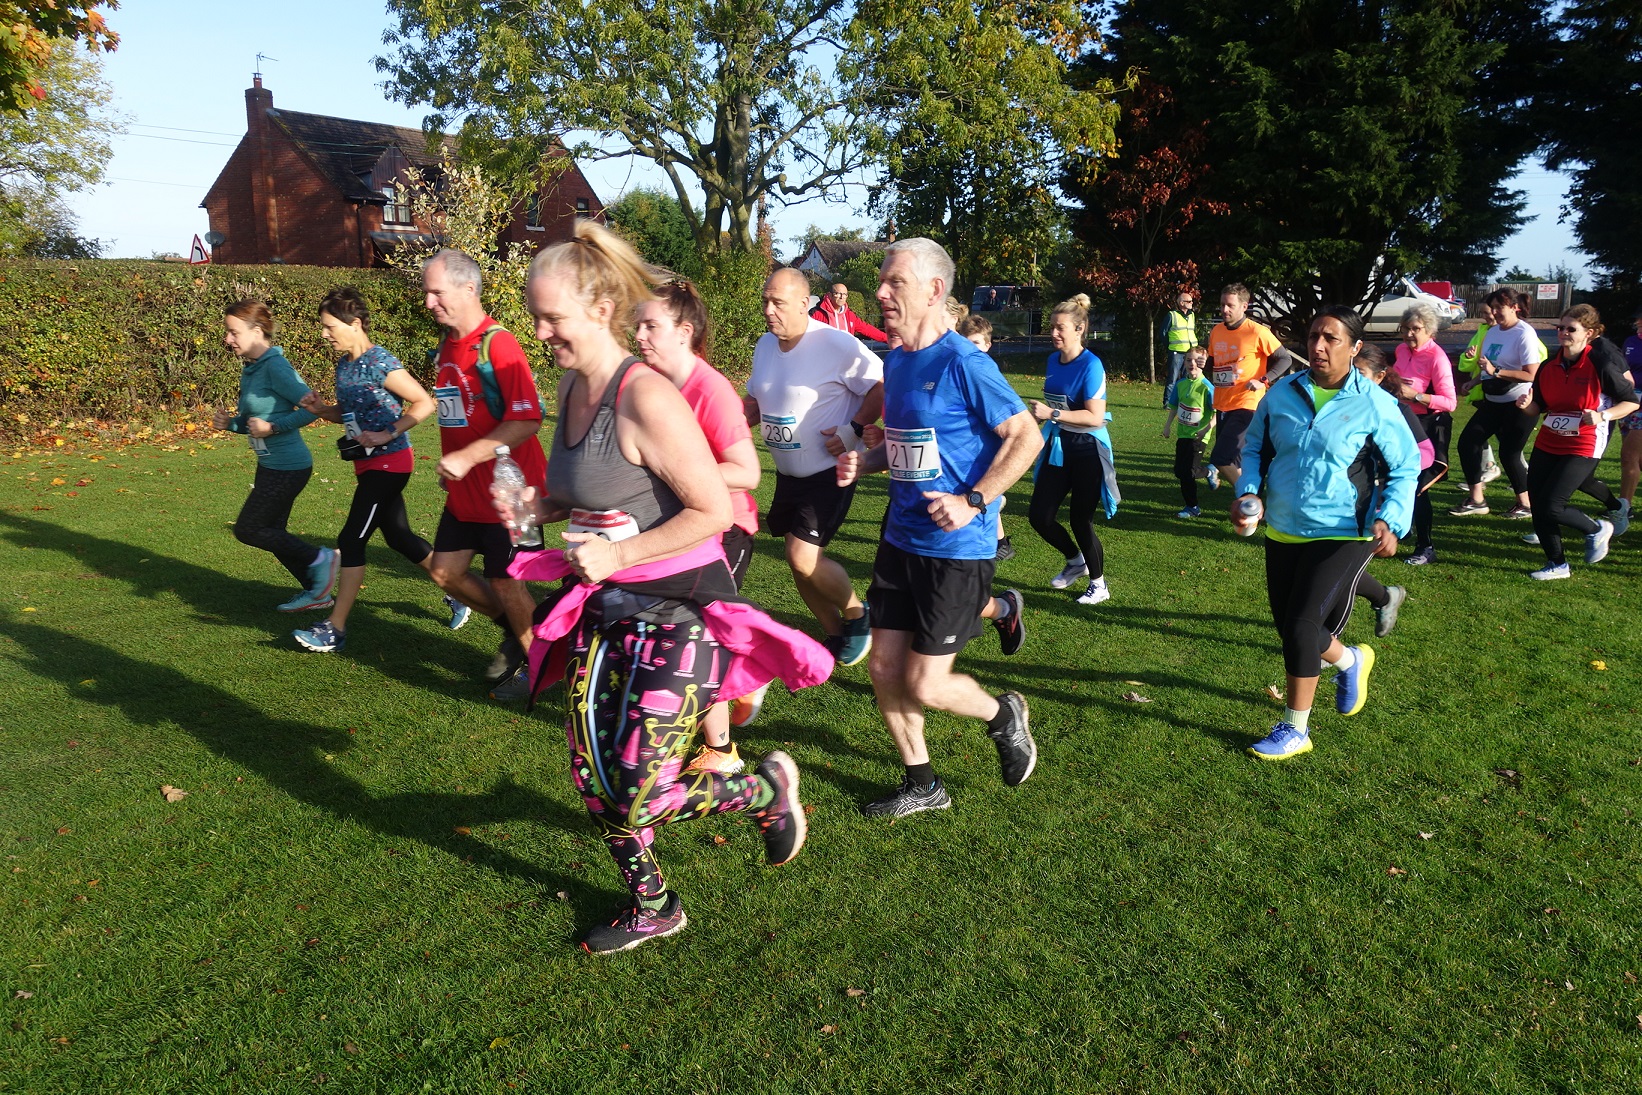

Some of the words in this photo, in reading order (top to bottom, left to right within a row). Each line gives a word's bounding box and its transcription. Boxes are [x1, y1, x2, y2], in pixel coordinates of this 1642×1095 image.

[1216, 372, 1228, 383] 42
[1180, 411, 1192, 421] 44
[1551, 417, 1570, 430] 62
[765, 424, 793, 443] 230
[890, 443, 924, 469] 217
